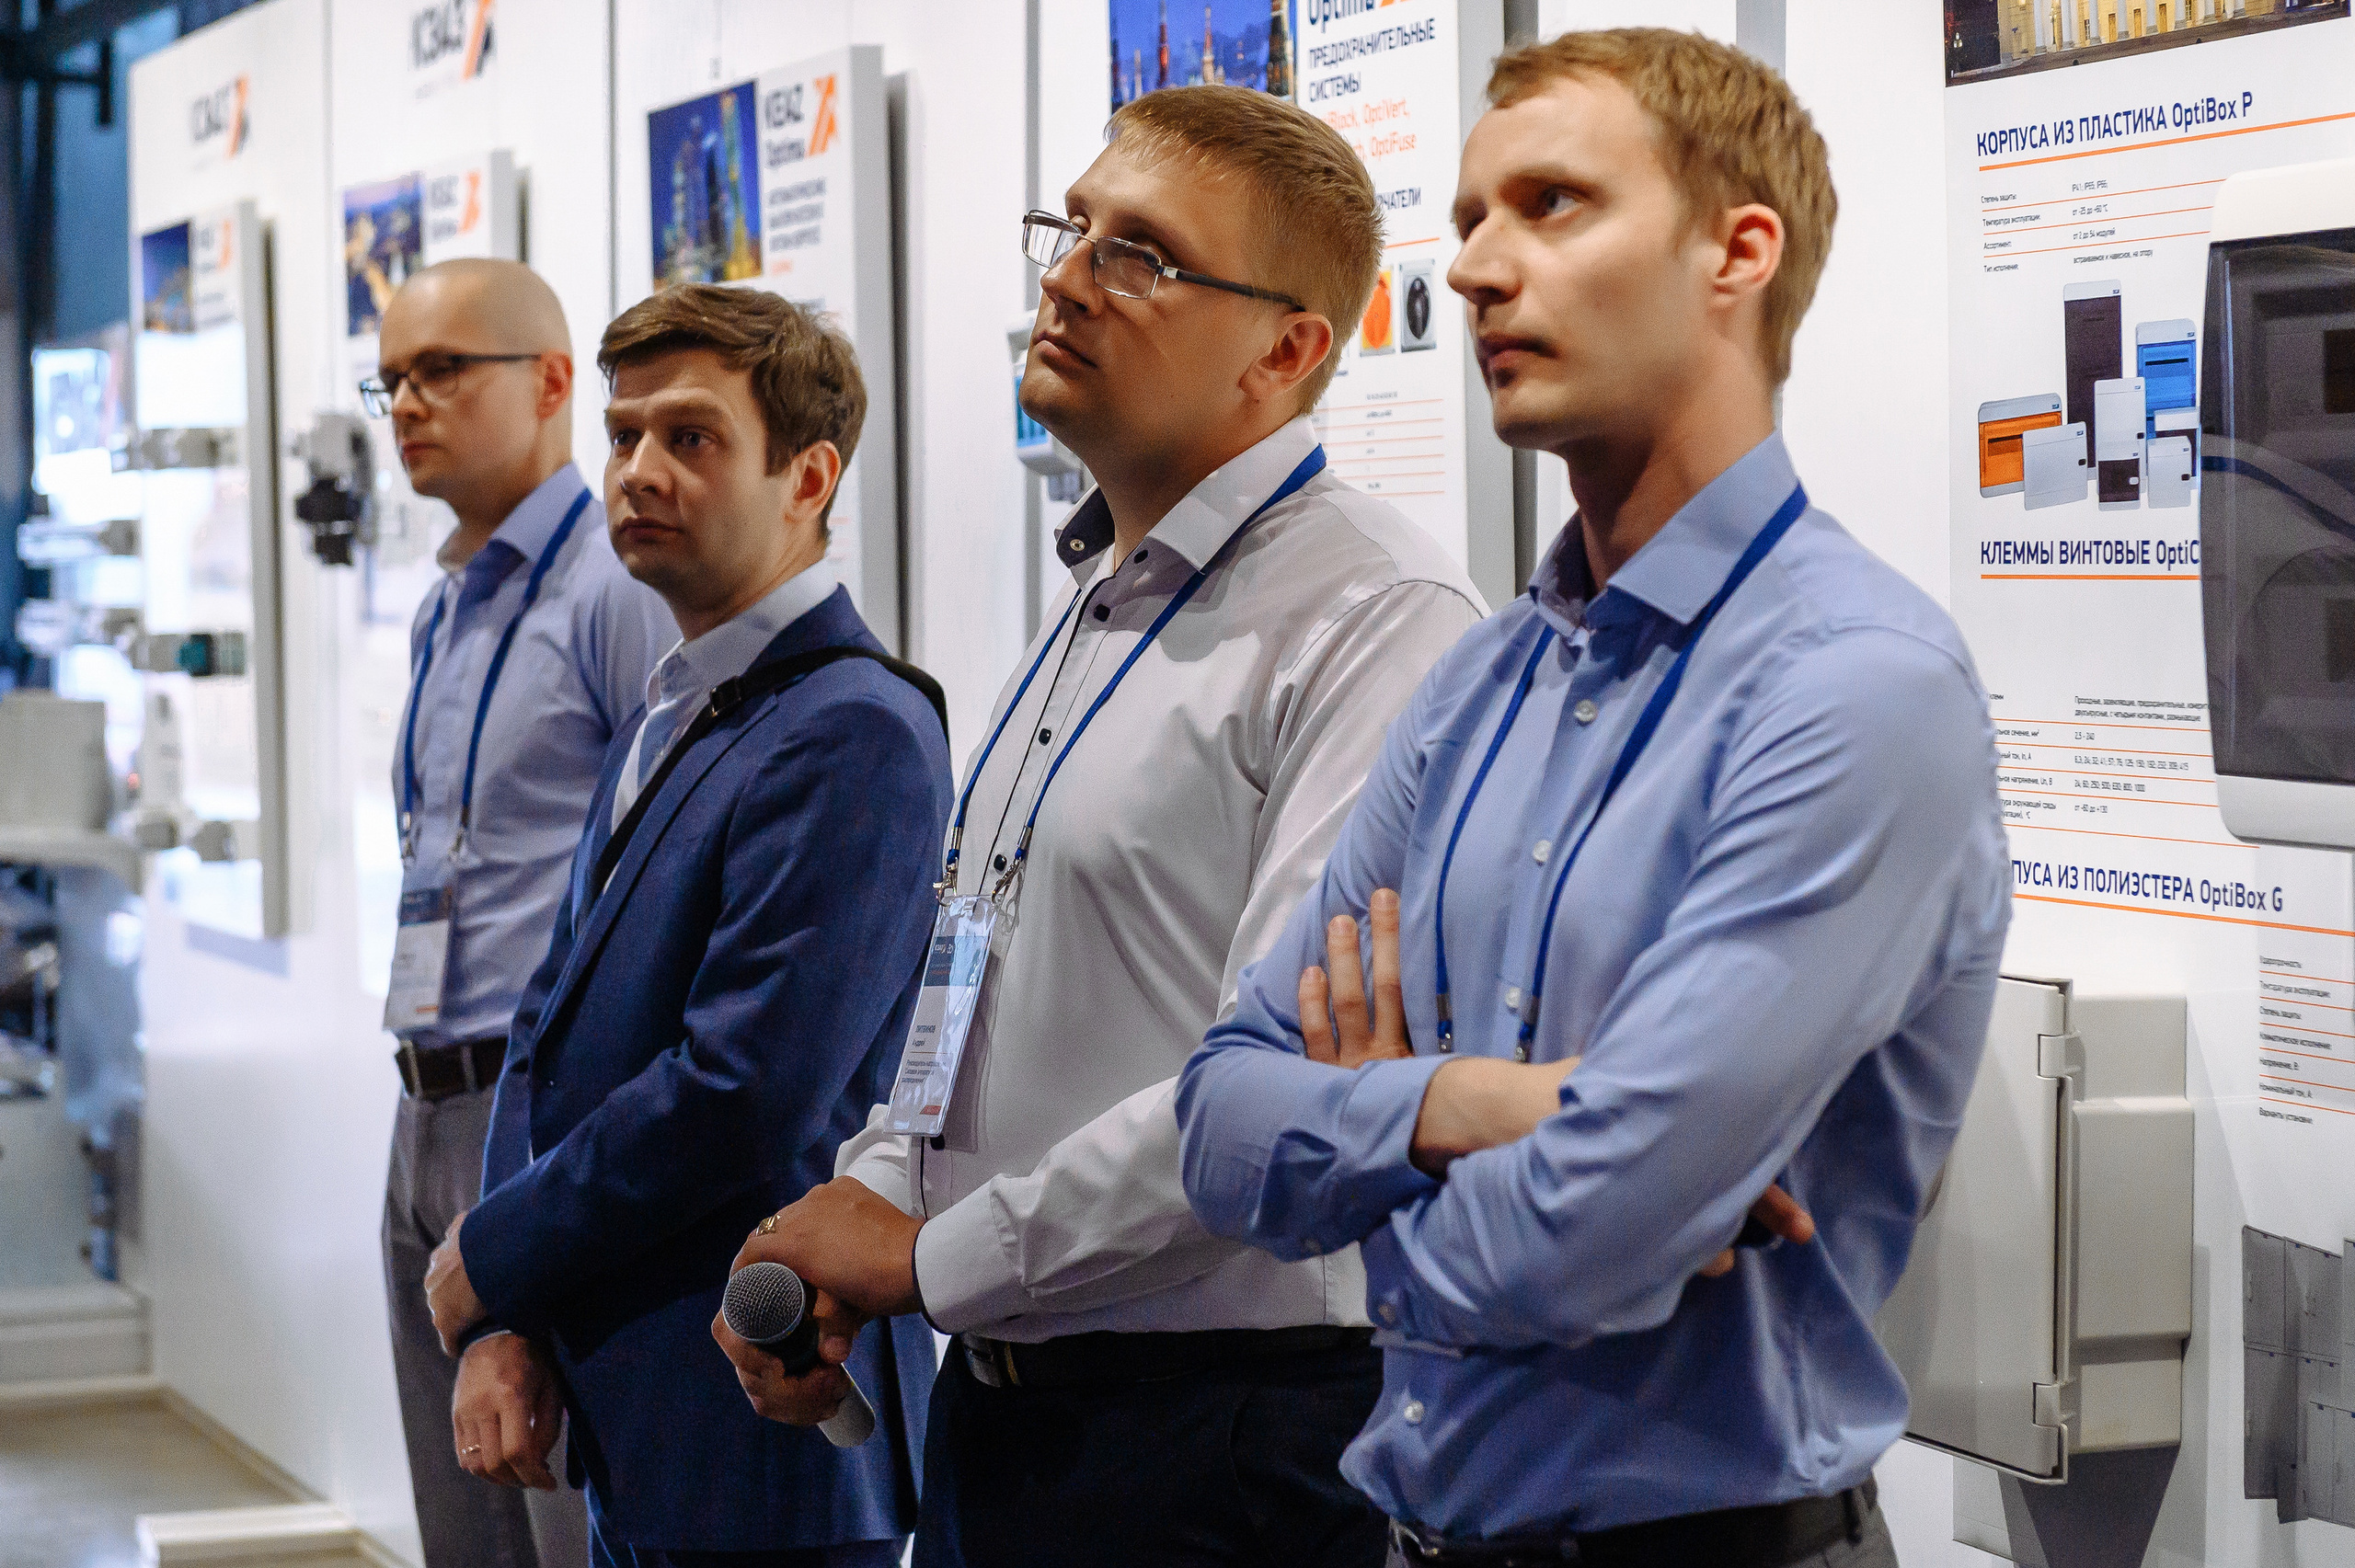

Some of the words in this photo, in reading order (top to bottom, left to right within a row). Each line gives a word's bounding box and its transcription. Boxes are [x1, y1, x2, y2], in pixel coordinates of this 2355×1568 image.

[1309, 17, 1436, 69] ПРЕДОХРАНИТЕЛЬНЫЕ
[1309, 71, 1361, 102] СИСТЕМЫ
[1977, 124, 2050, 156] КОРПУСА
[2053, 120, 2074, 145] ИЗ
[2079, 105, 2167, 142] ПЛАСТИКА
[2172, 97, 2237, 132] OptiBox
[1981, 541, 2054, 565] КЛЕММЫ
[2059, 540, 2151, 565] ВИНТОВЫЕ
[2156, 540, 2200, 571] OptiC
[2011, 859, 2053, 887] ПУСА
[2057, 864, 2079, 890] ИЗ
[2084, 866, 2195, 902] ПОЛИЭСТЕРА
[2200, 878, 2268, 911] OptiBox
[2272, 887, 2283, 911] G
